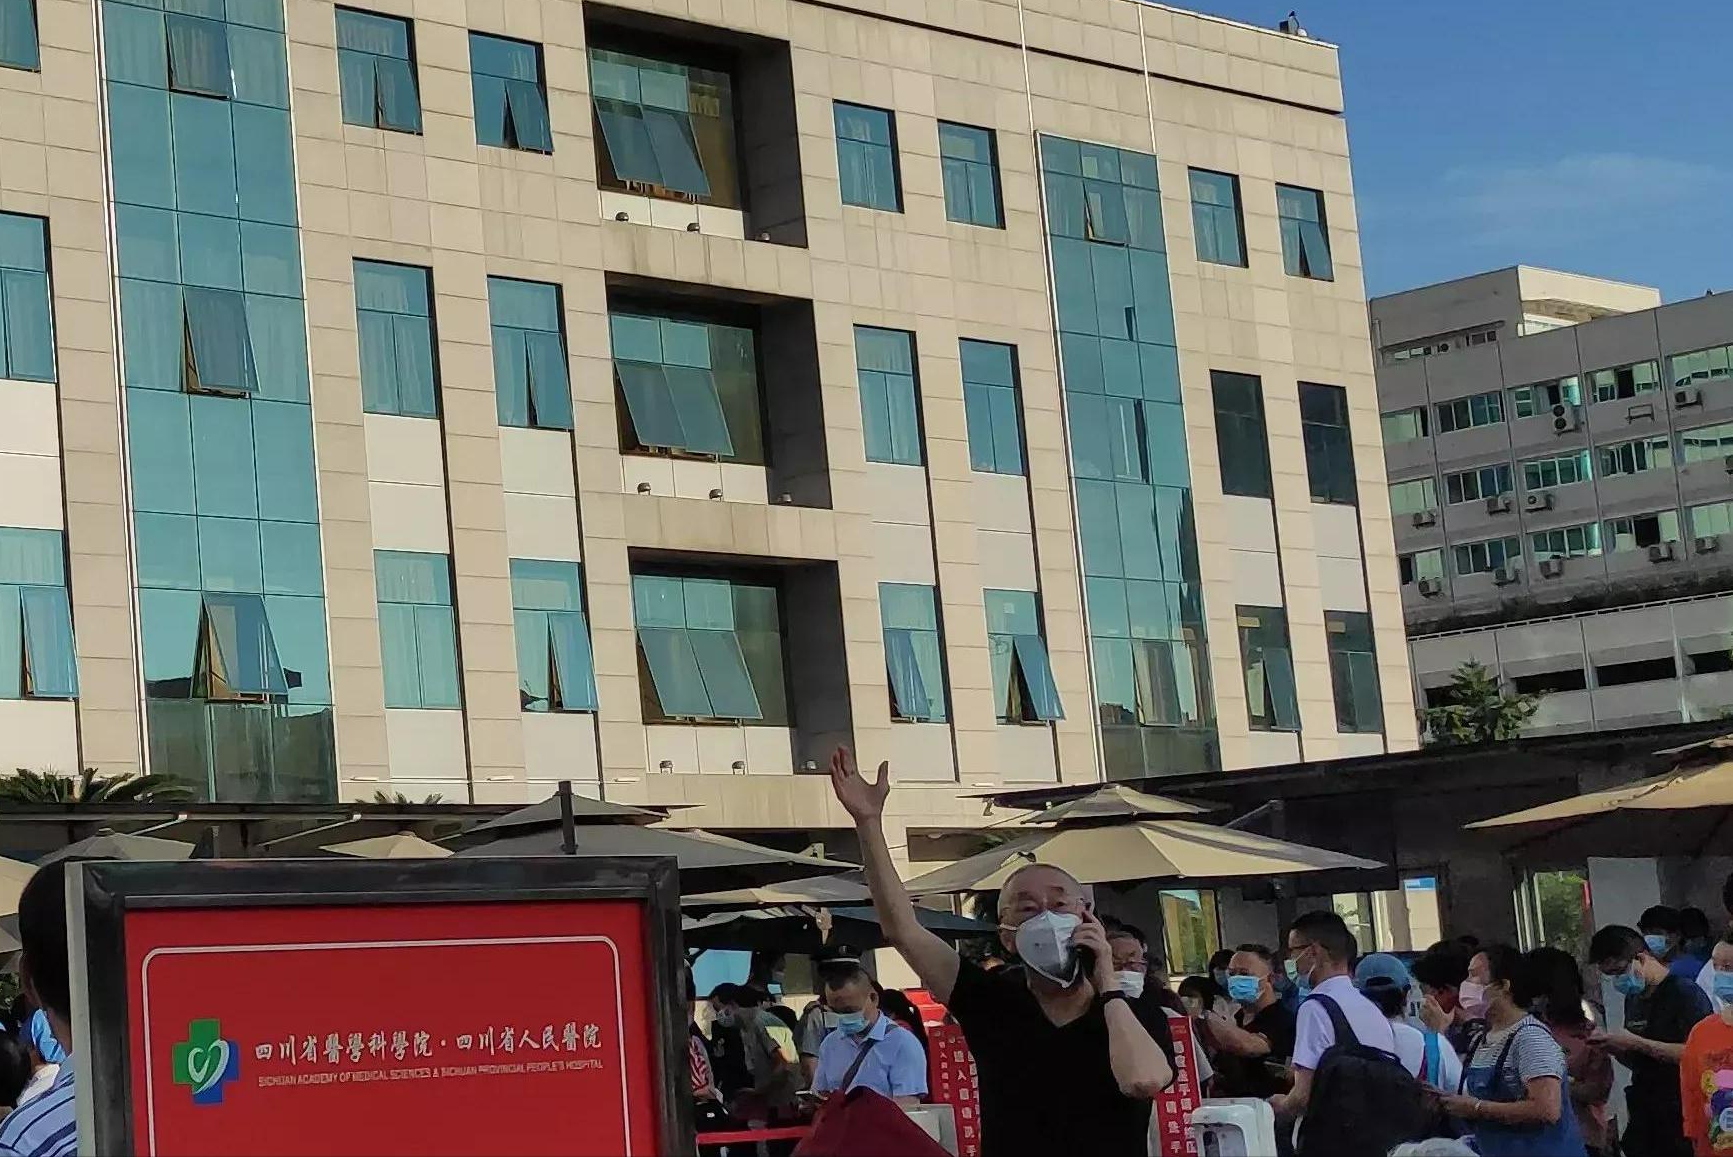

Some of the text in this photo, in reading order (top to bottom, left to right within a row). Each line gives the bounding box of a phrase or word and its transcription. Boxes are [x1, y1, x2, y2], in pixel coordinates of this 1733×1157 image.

[297, 1072, 338, 1085] ACADEMY
[339, 1071, 351, 1082] OF
[352, 1070, 388, 1082] MEDICAL
[390, 1067, 431, 1080] SCIENCES
[566, 1058, 604, 1070] HOSPITAL
